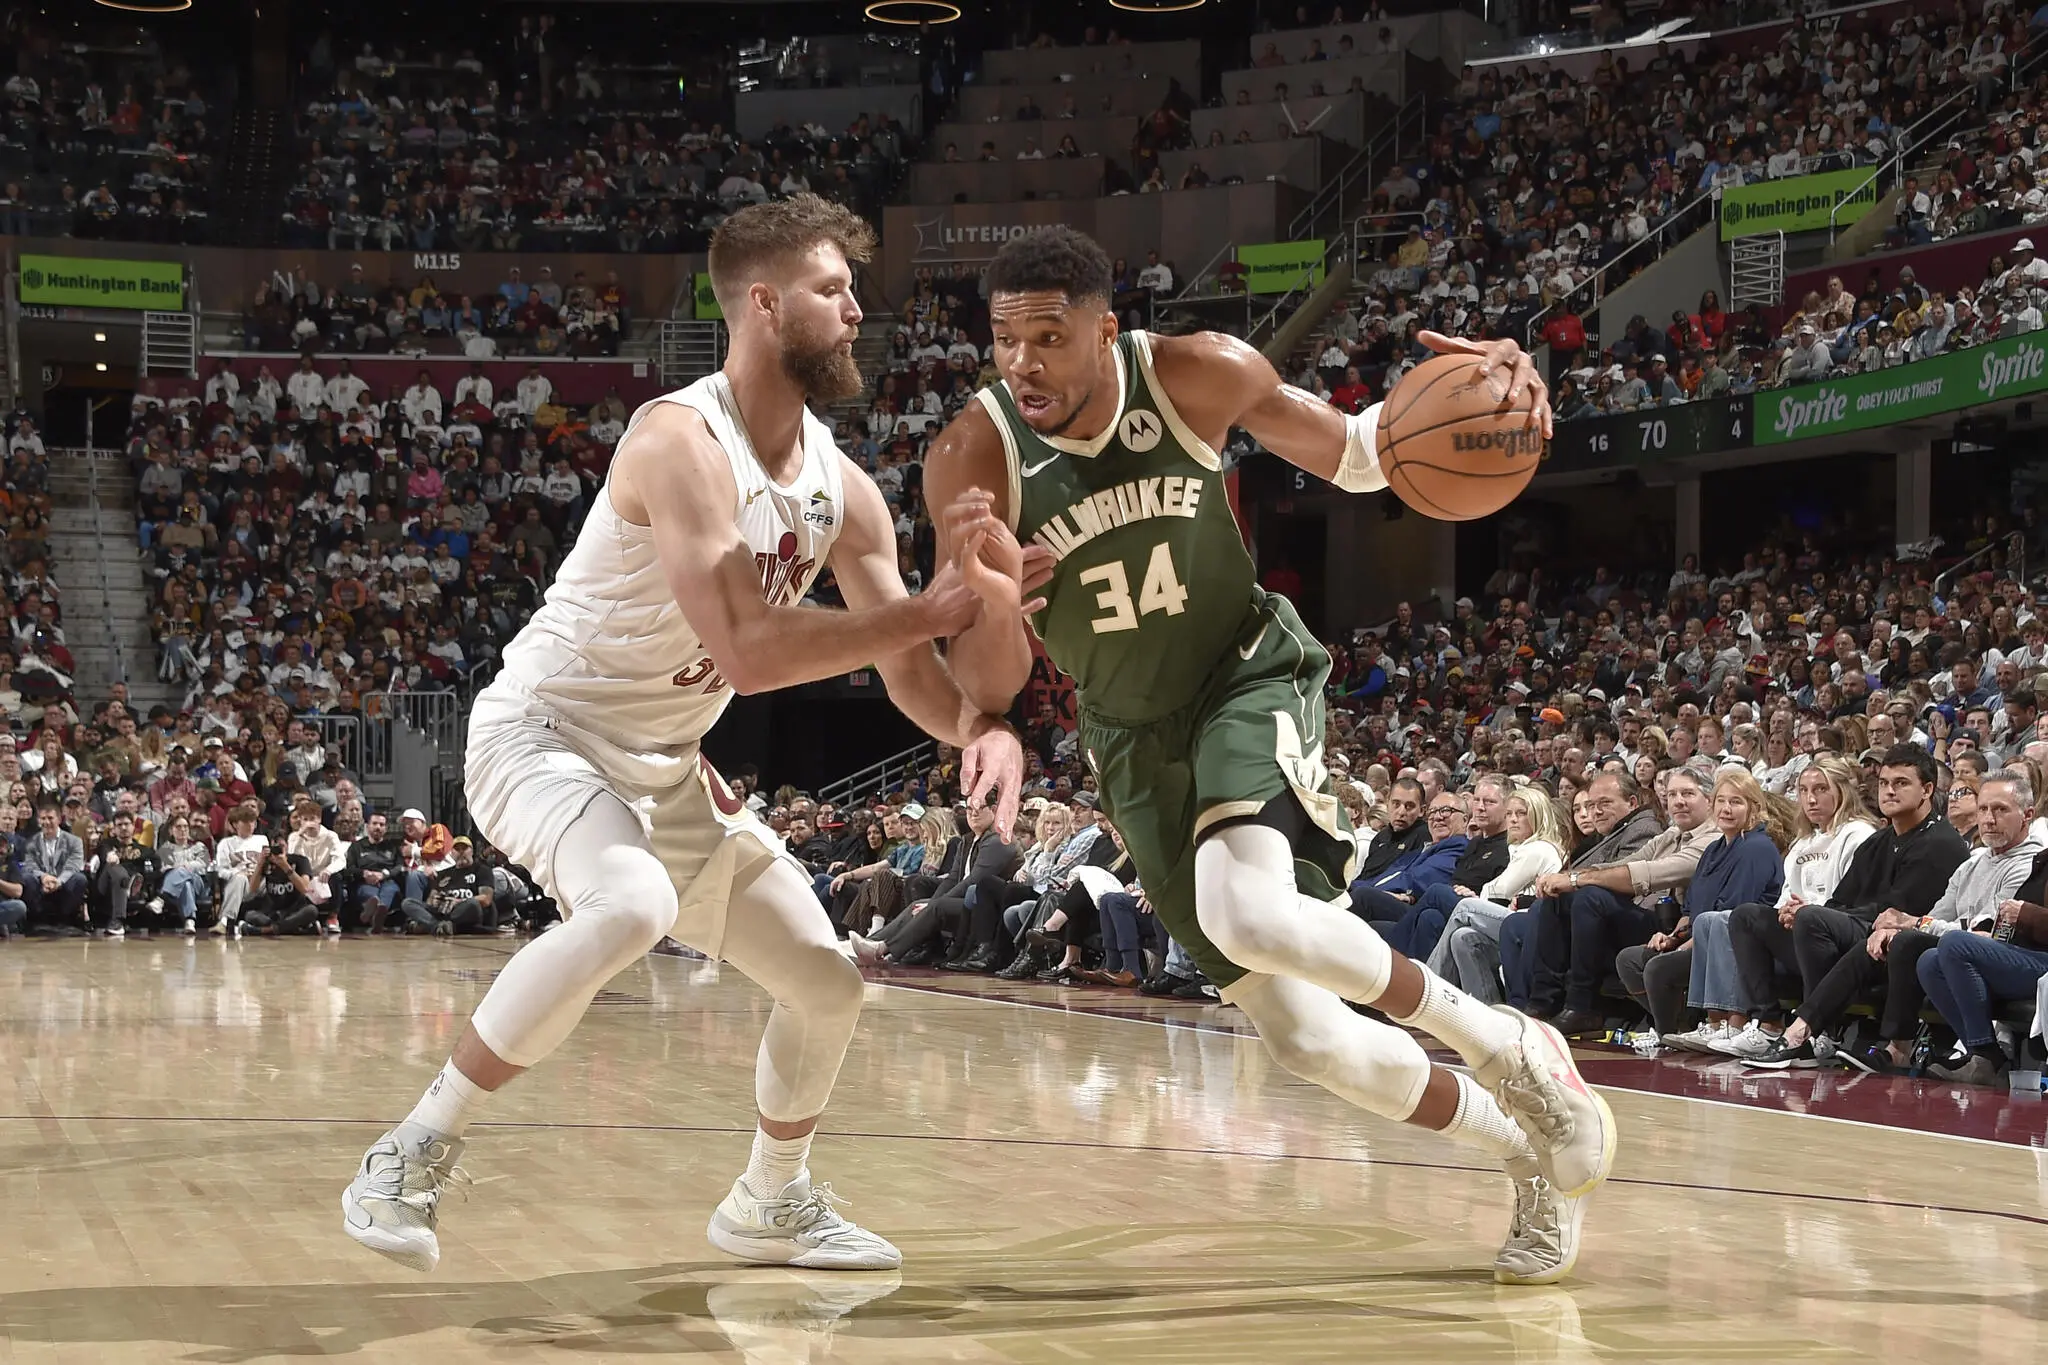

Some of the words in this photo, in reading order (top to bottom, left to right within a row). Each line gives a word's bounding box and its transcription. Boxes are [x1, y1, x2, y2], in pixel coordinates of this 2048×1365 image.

[1746, 194, 1831, 219] Huntington
[414, 253, 461, 270] M115
[47, 272, 136, 295] Huntington
[140, 278, 181, 294] Bank
[1978, 341, 2046, 397] Sprite
[1774, 387, 1848, 437] Sprite
[1856, 391, 1883, 412] OBEY
[1883, 385, 1910, 406] YOUR
[1911, 377, 1943, 400] THIRST
[1588, 434, 1609, 453] 16
[1638, 419, 1668, 451] 70
[1731, 418, 1742, 440] 4
[1295, 471, 1306, 490] 5
[803, 511, 834, 526] CFFS
[1079, 541, 1188, 634] 34
